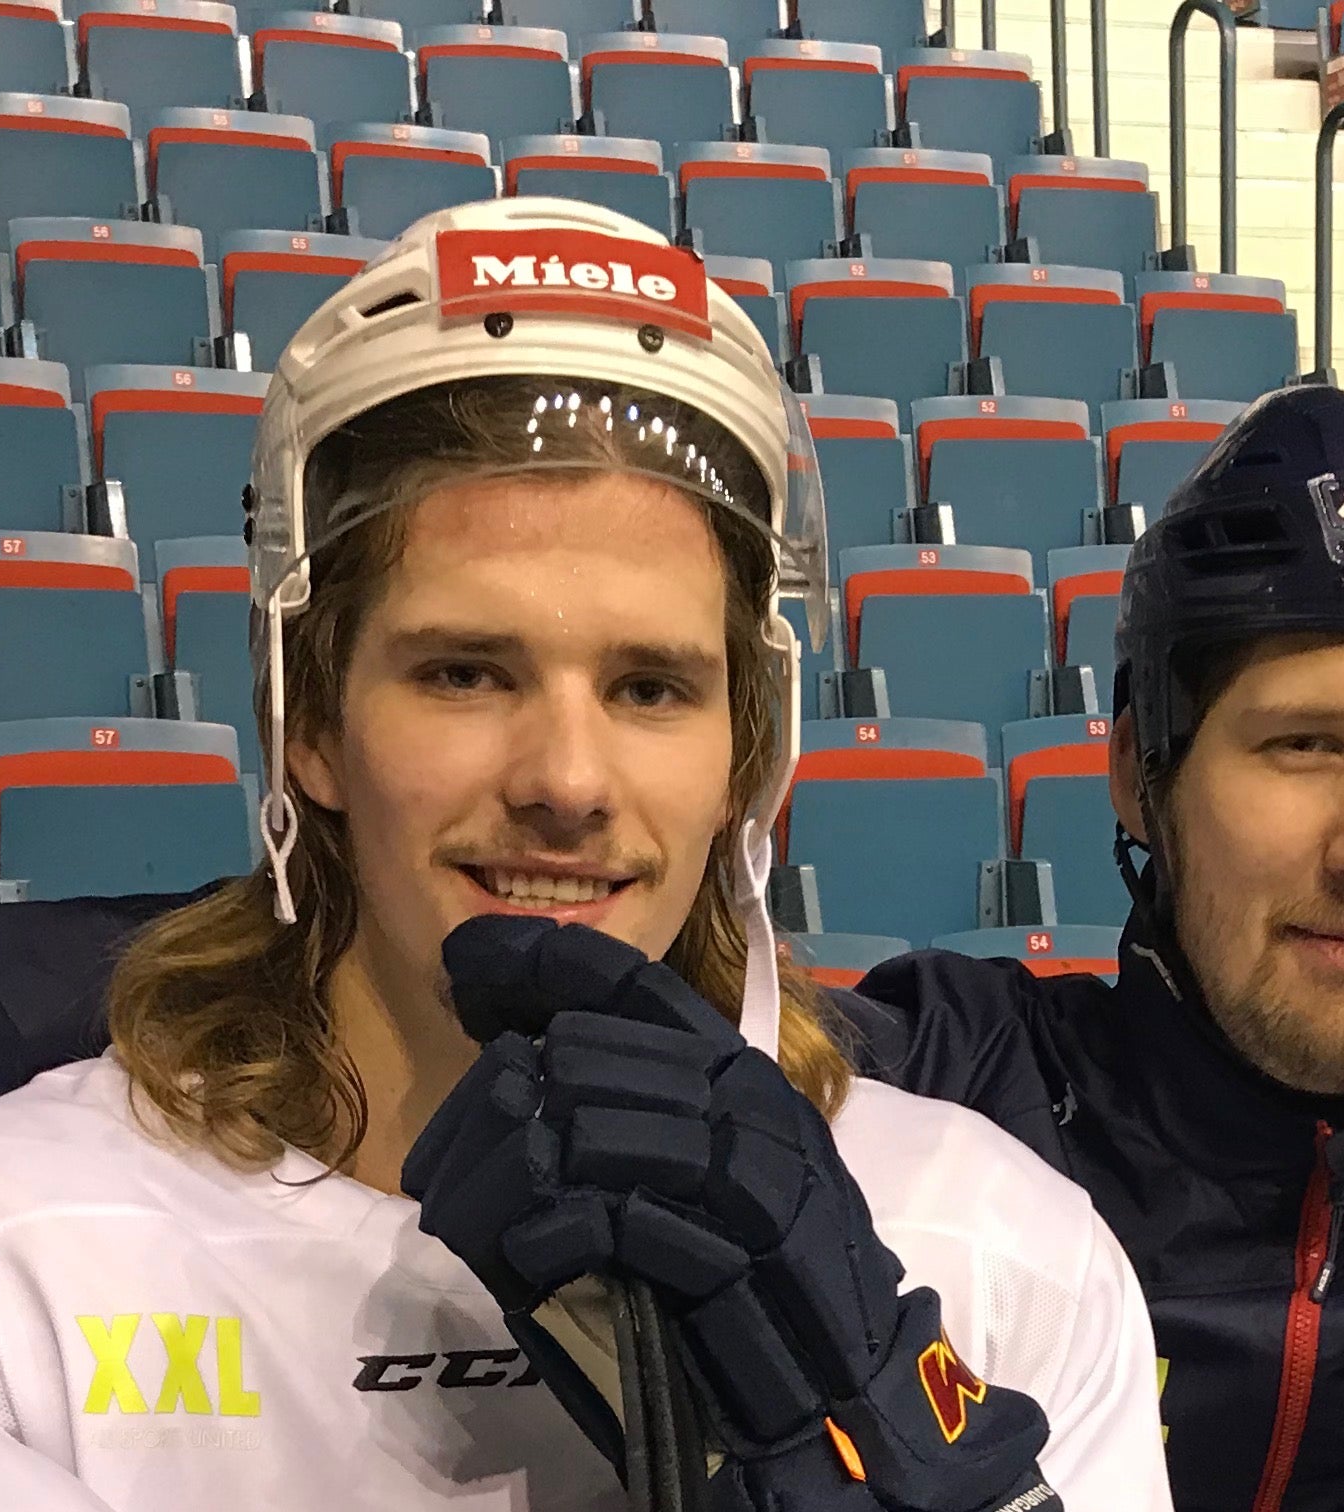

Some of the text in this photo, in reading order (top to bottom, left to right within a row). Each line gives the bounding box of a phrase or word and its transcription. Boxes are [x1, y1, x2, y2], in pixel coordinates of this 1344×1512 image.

[292, 238, 306, 249] 55
[851, 264, 864, 275] 52
[1033, 269, 1046, 280] 51
[472, 255, 677, 301] Miele
[1195, 277, 1208, 287] 50
[175, 373, 191, 384] 56
[981, 402, 995, 412] 52
[1172, 406, 1185, 416] 51
[4, 540, 21, 552] 57
[921, 551, 936, 563] 53
[859, 727, 876, 740] 54
[1089, 722, 1106, 734] 53
[95, 730, 115, 744] 57
[1031, 936, 1048, 950] 54
[75, 1313, 262, 1417] XXL
[353, 1348, 545, 1391] CC
